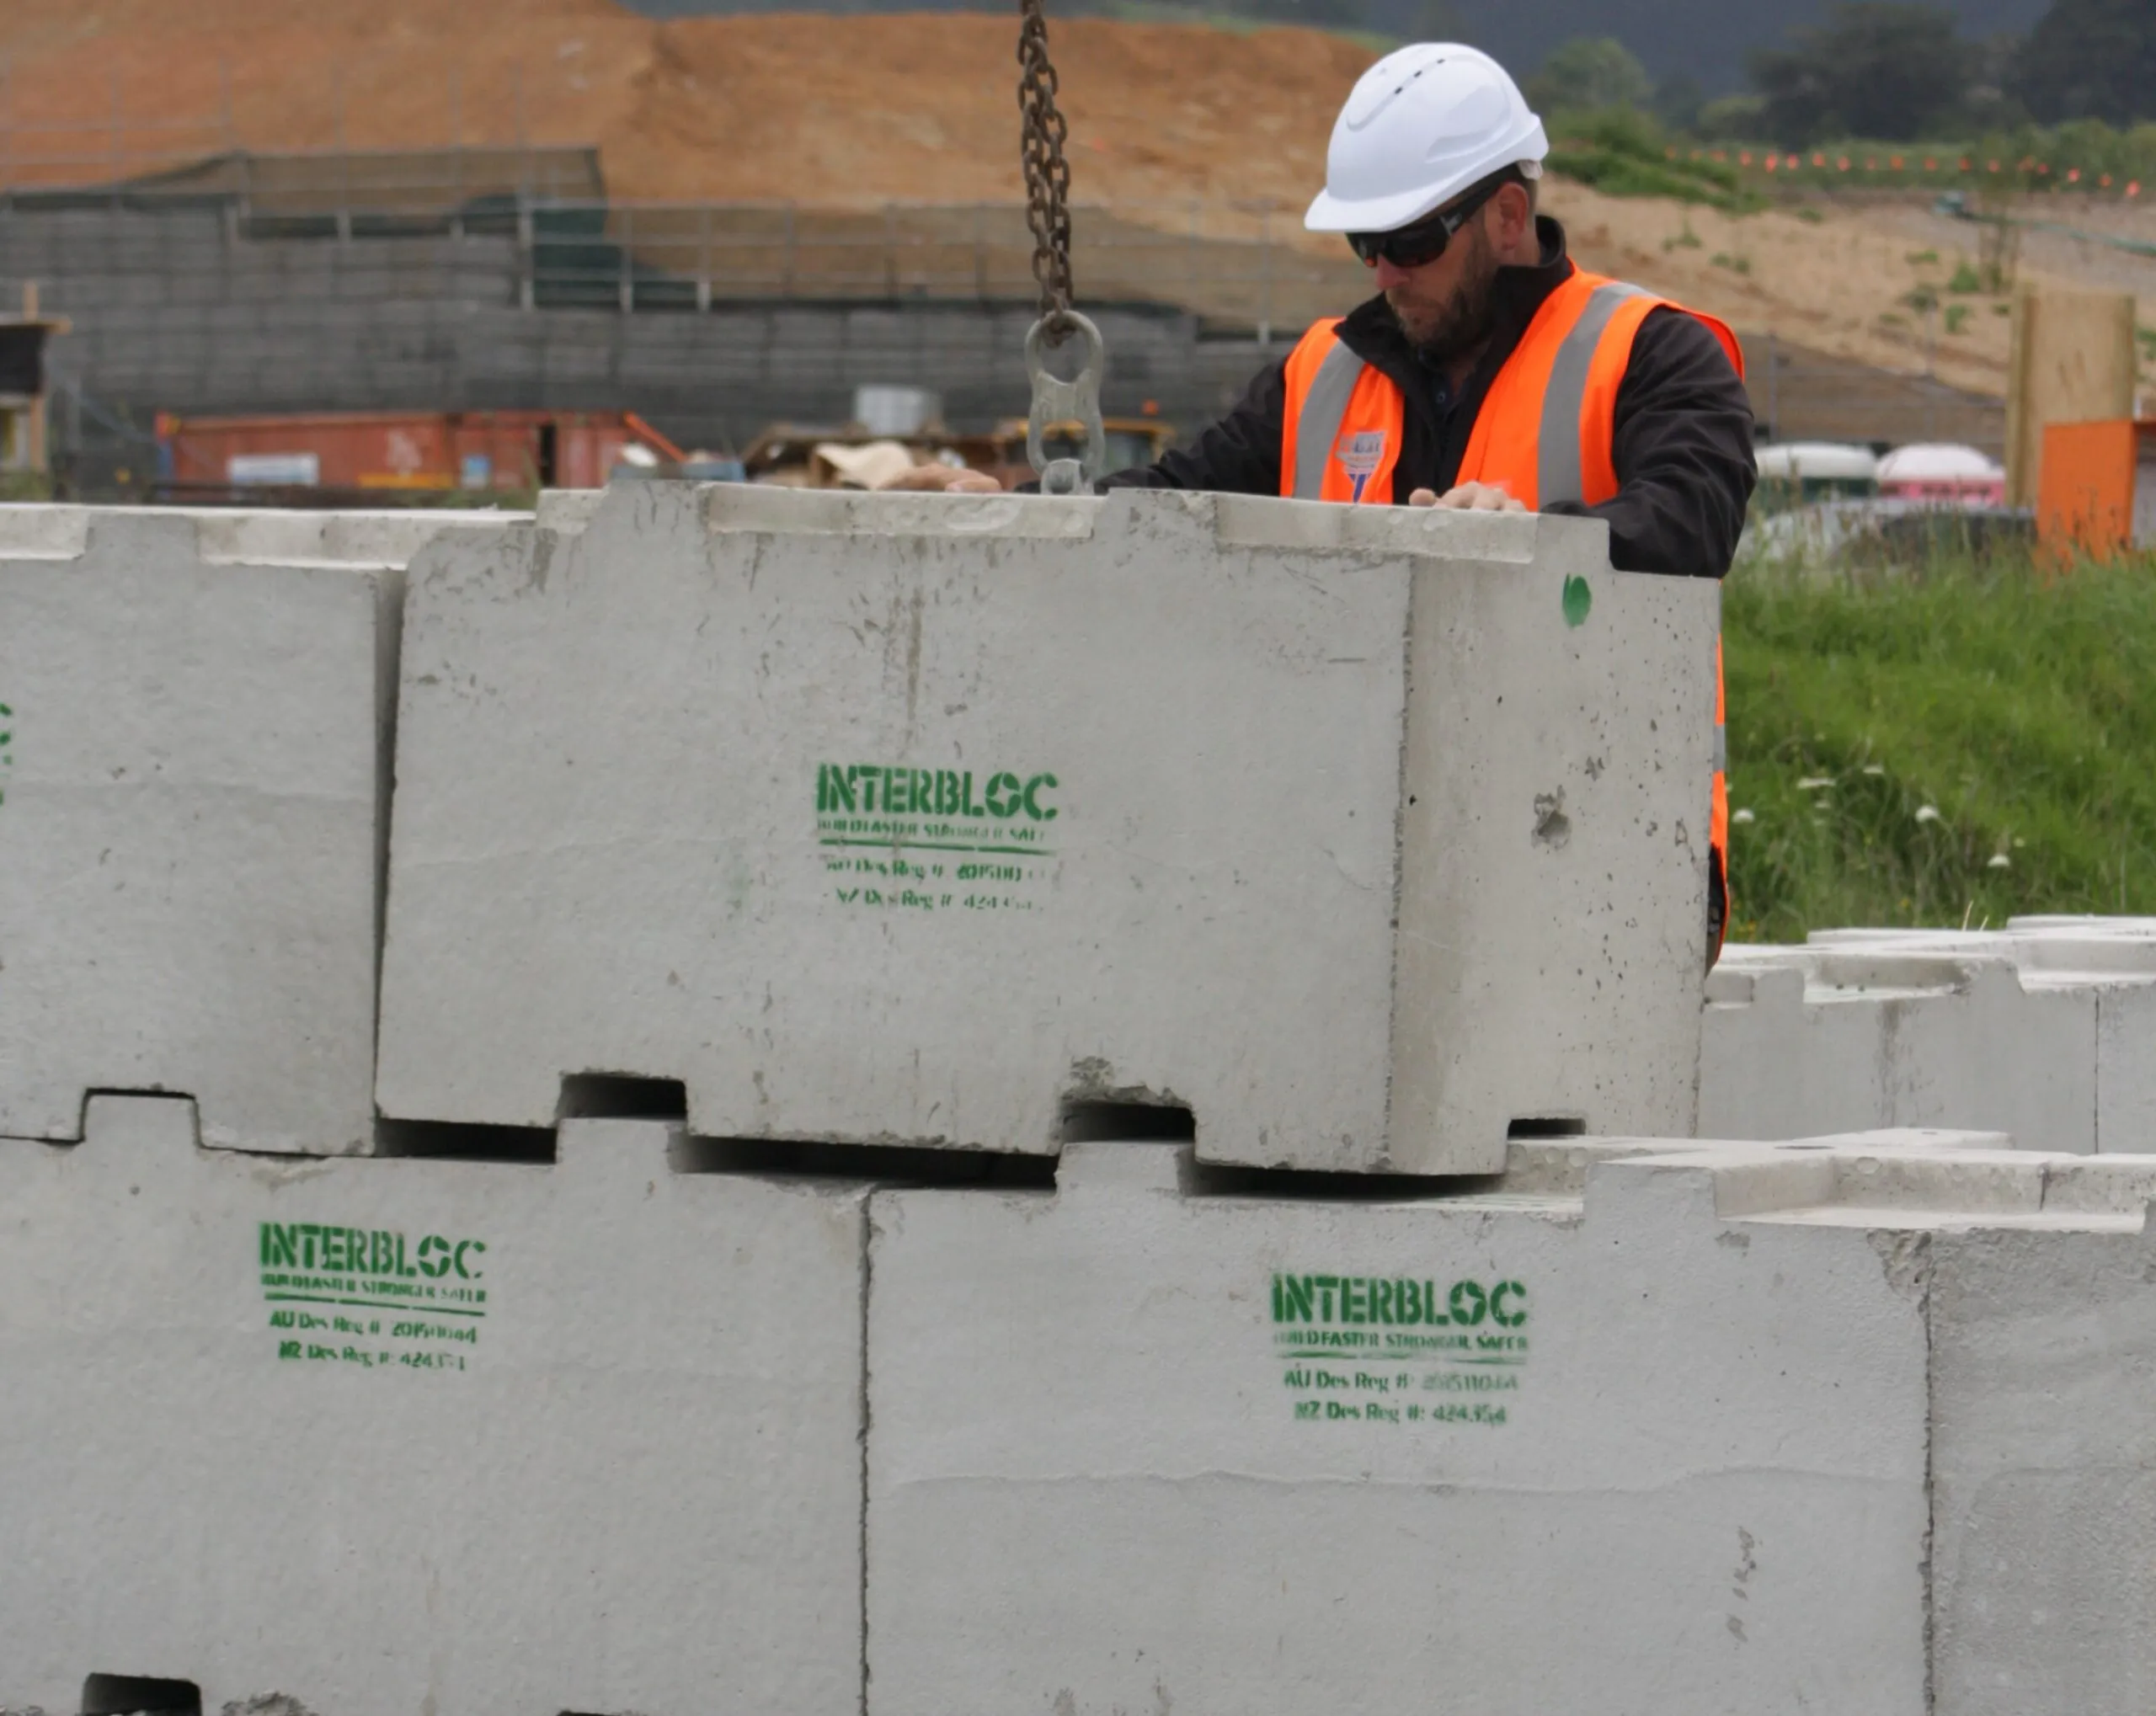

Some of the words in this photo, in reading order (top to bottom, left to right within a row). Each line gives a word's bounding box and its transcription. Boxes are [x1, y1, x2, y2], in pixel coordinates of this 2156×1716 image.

[817, 763, 1059, 821] INTERBLOC
[259, 1223, 487, 1280] INTERBLOC
[1272, 1274, 1527, 1327] INTERBLOC
[1283, 1369, 1310, 1388] AU
[1315, 1371, 1349, 1389] Des
[1355, 1372, 1389, 1394] Reg
[1326, 1401, 1360, 1420] Des
